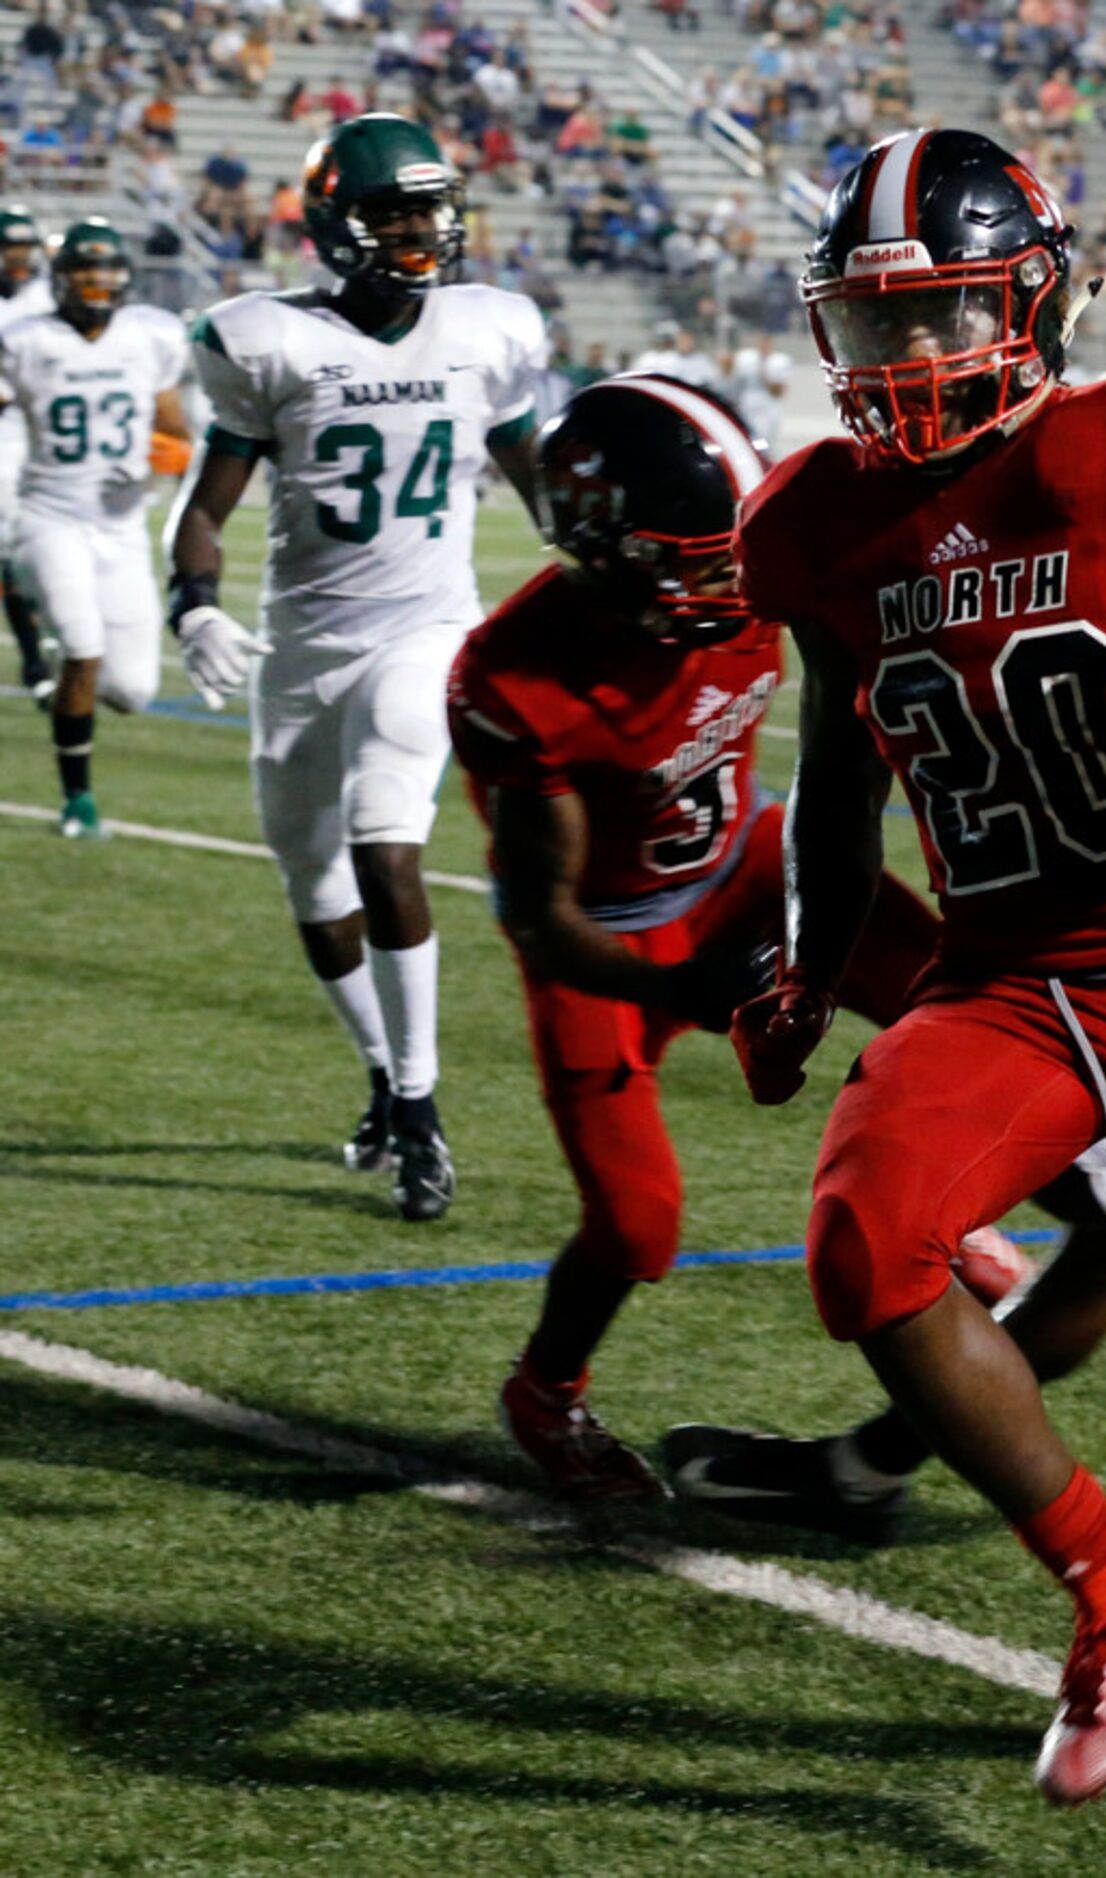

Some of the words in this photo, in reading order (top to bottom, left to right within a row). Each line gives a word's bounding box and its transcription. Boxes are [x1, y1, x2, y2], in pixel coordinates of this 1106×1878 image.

[852, 244, 915, 265] Riddell
[341, 380, 445, 407] NAAMAN
[49, 392, 134, 464] 93
[315, 420, 453, 545] 34
[929, 539, 989, 565] adidas
[878, 550, 1069, 645] NORTH
